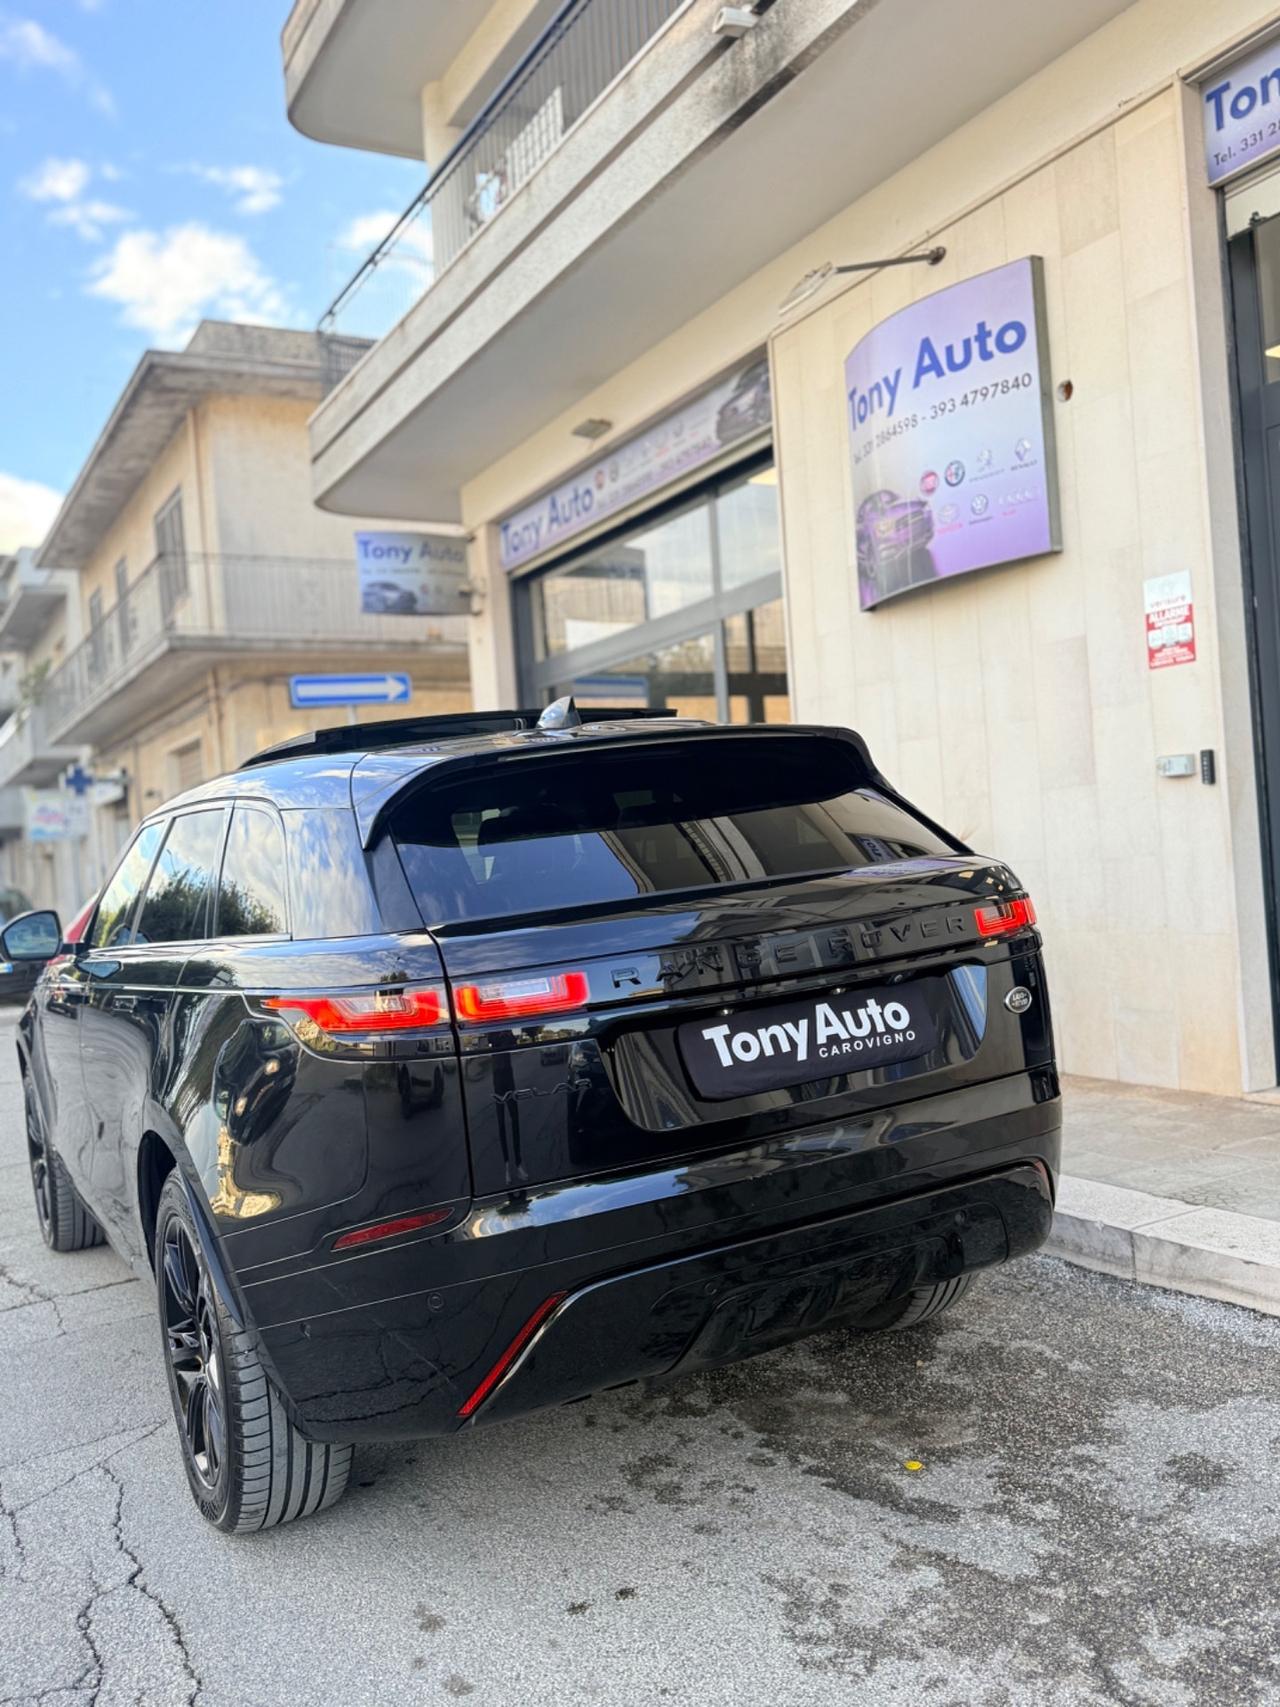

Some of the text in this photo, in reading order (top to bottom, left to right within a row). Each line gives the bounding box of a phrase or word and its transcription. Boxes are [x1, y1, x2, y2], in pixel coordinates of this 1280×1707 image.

[1213, 146, 1236, 166] Tel.
[1240, 129, 1263, 152] 331
[849, 321, 1027, 431] Tony Auto
[930, 398, 956, 420] 393
[960, 372, 1032, 407] 4797840
[501, 486, 593, 557] Tony Auto
[358, 540, 464, 564] Tony Auto
[828, 916, 966, 957] ROVER
[701, 998, 910, 1068] Tony Auto
[818, 1030, 916, 1058] CAROVIGNO
